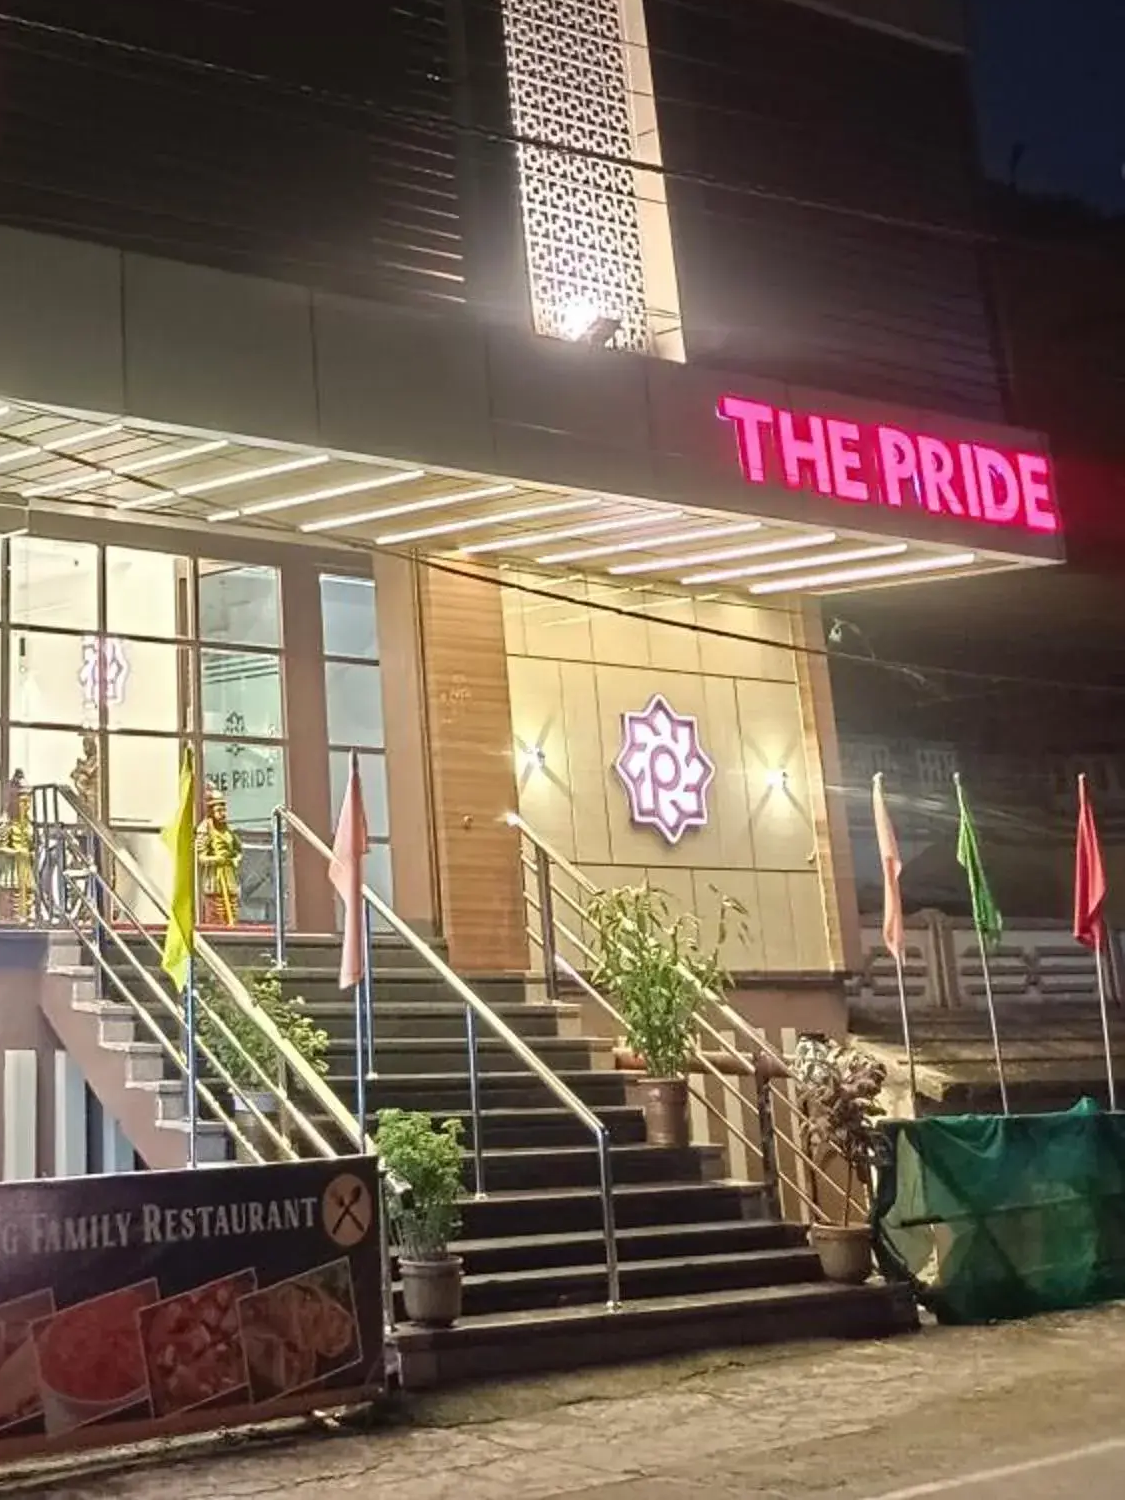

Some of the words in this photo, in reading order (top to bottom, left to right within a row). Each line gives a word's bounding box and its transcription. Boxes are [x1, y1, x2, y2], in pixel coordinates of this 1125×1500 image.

[717, 396, 869, 501] THE
[877, 426, 1058, 531] PRIDE
[232, 767, 275, 790] PRIDE
[30, 1212, 132, 1254] FAMILY
[143, 1197, 317, 1244] RESTAURANT
